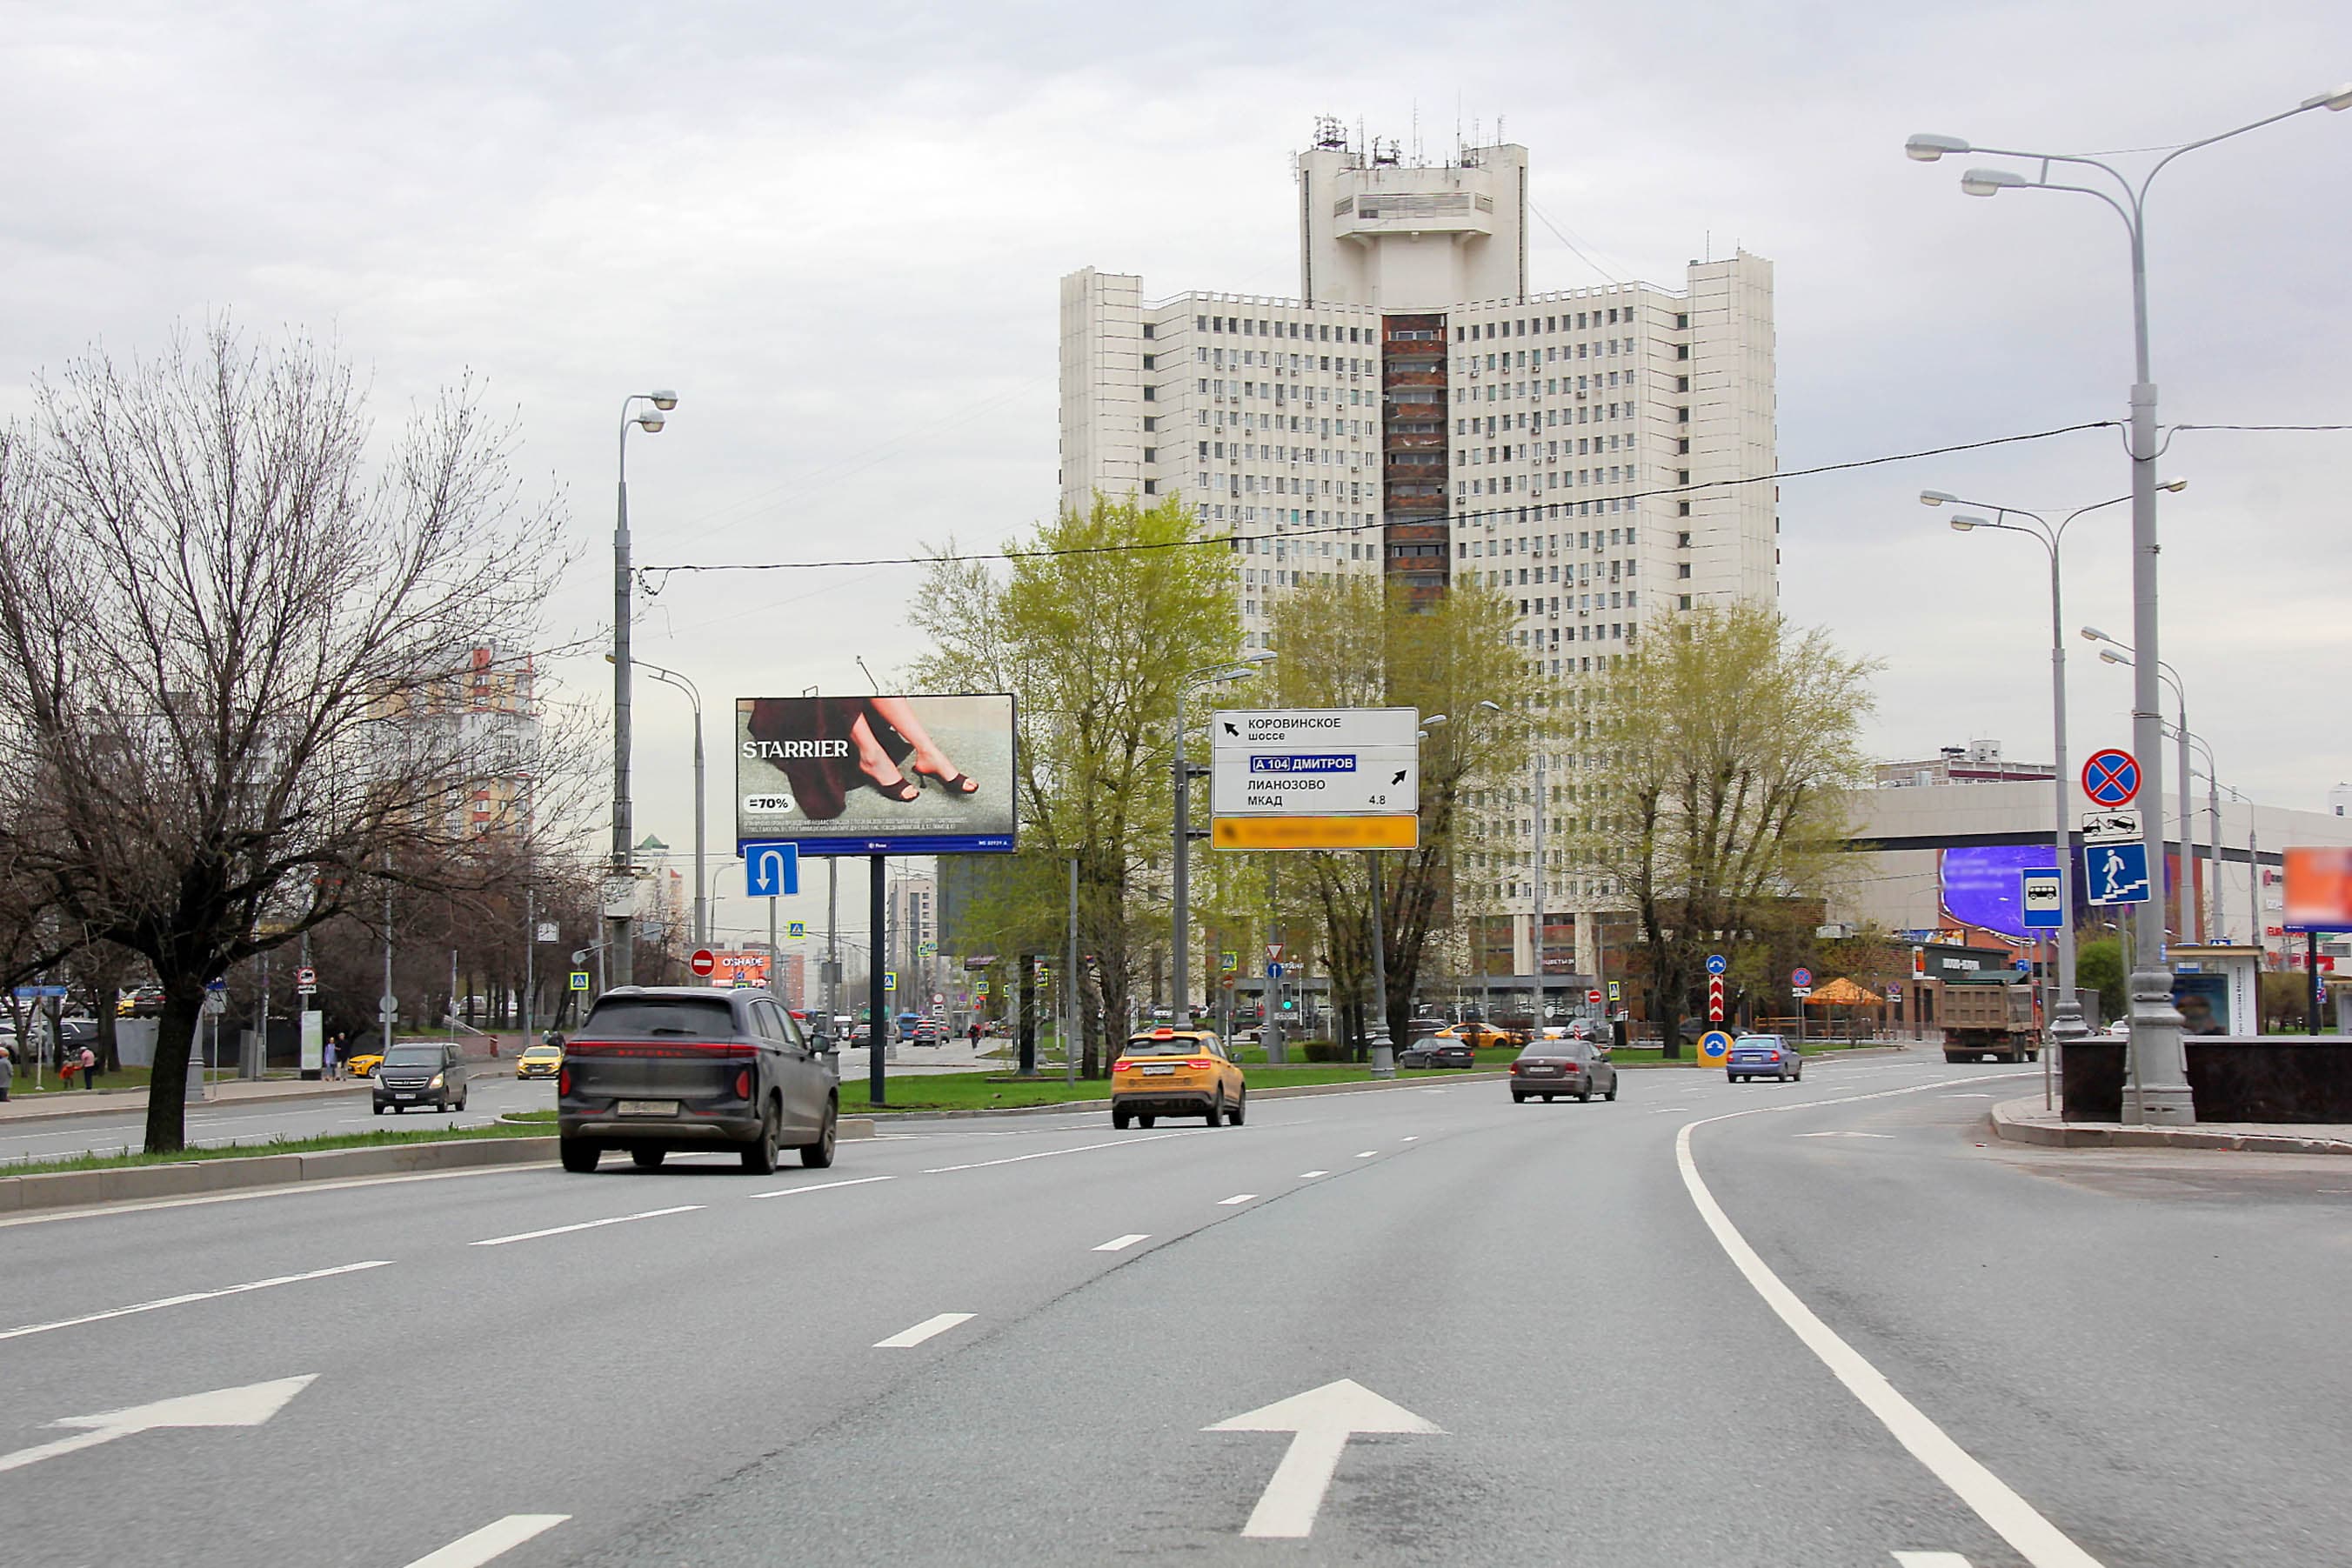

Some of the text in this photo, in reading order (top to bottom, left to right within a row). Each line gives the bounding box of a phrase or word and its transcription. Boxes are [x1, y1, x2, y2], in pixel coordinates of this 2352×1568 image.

[1248, 717, 1341, 729] КОРОВИНСКОЕ
[742, 739, 849, 758] STARRIER
[1255, 758, 1353, 771] А 104 ДМИТРОВ
[1247, 779, 1326, 790] ЛИАНОЗОВО
[1247, 795, 1386, 806] МКАД 4.8
